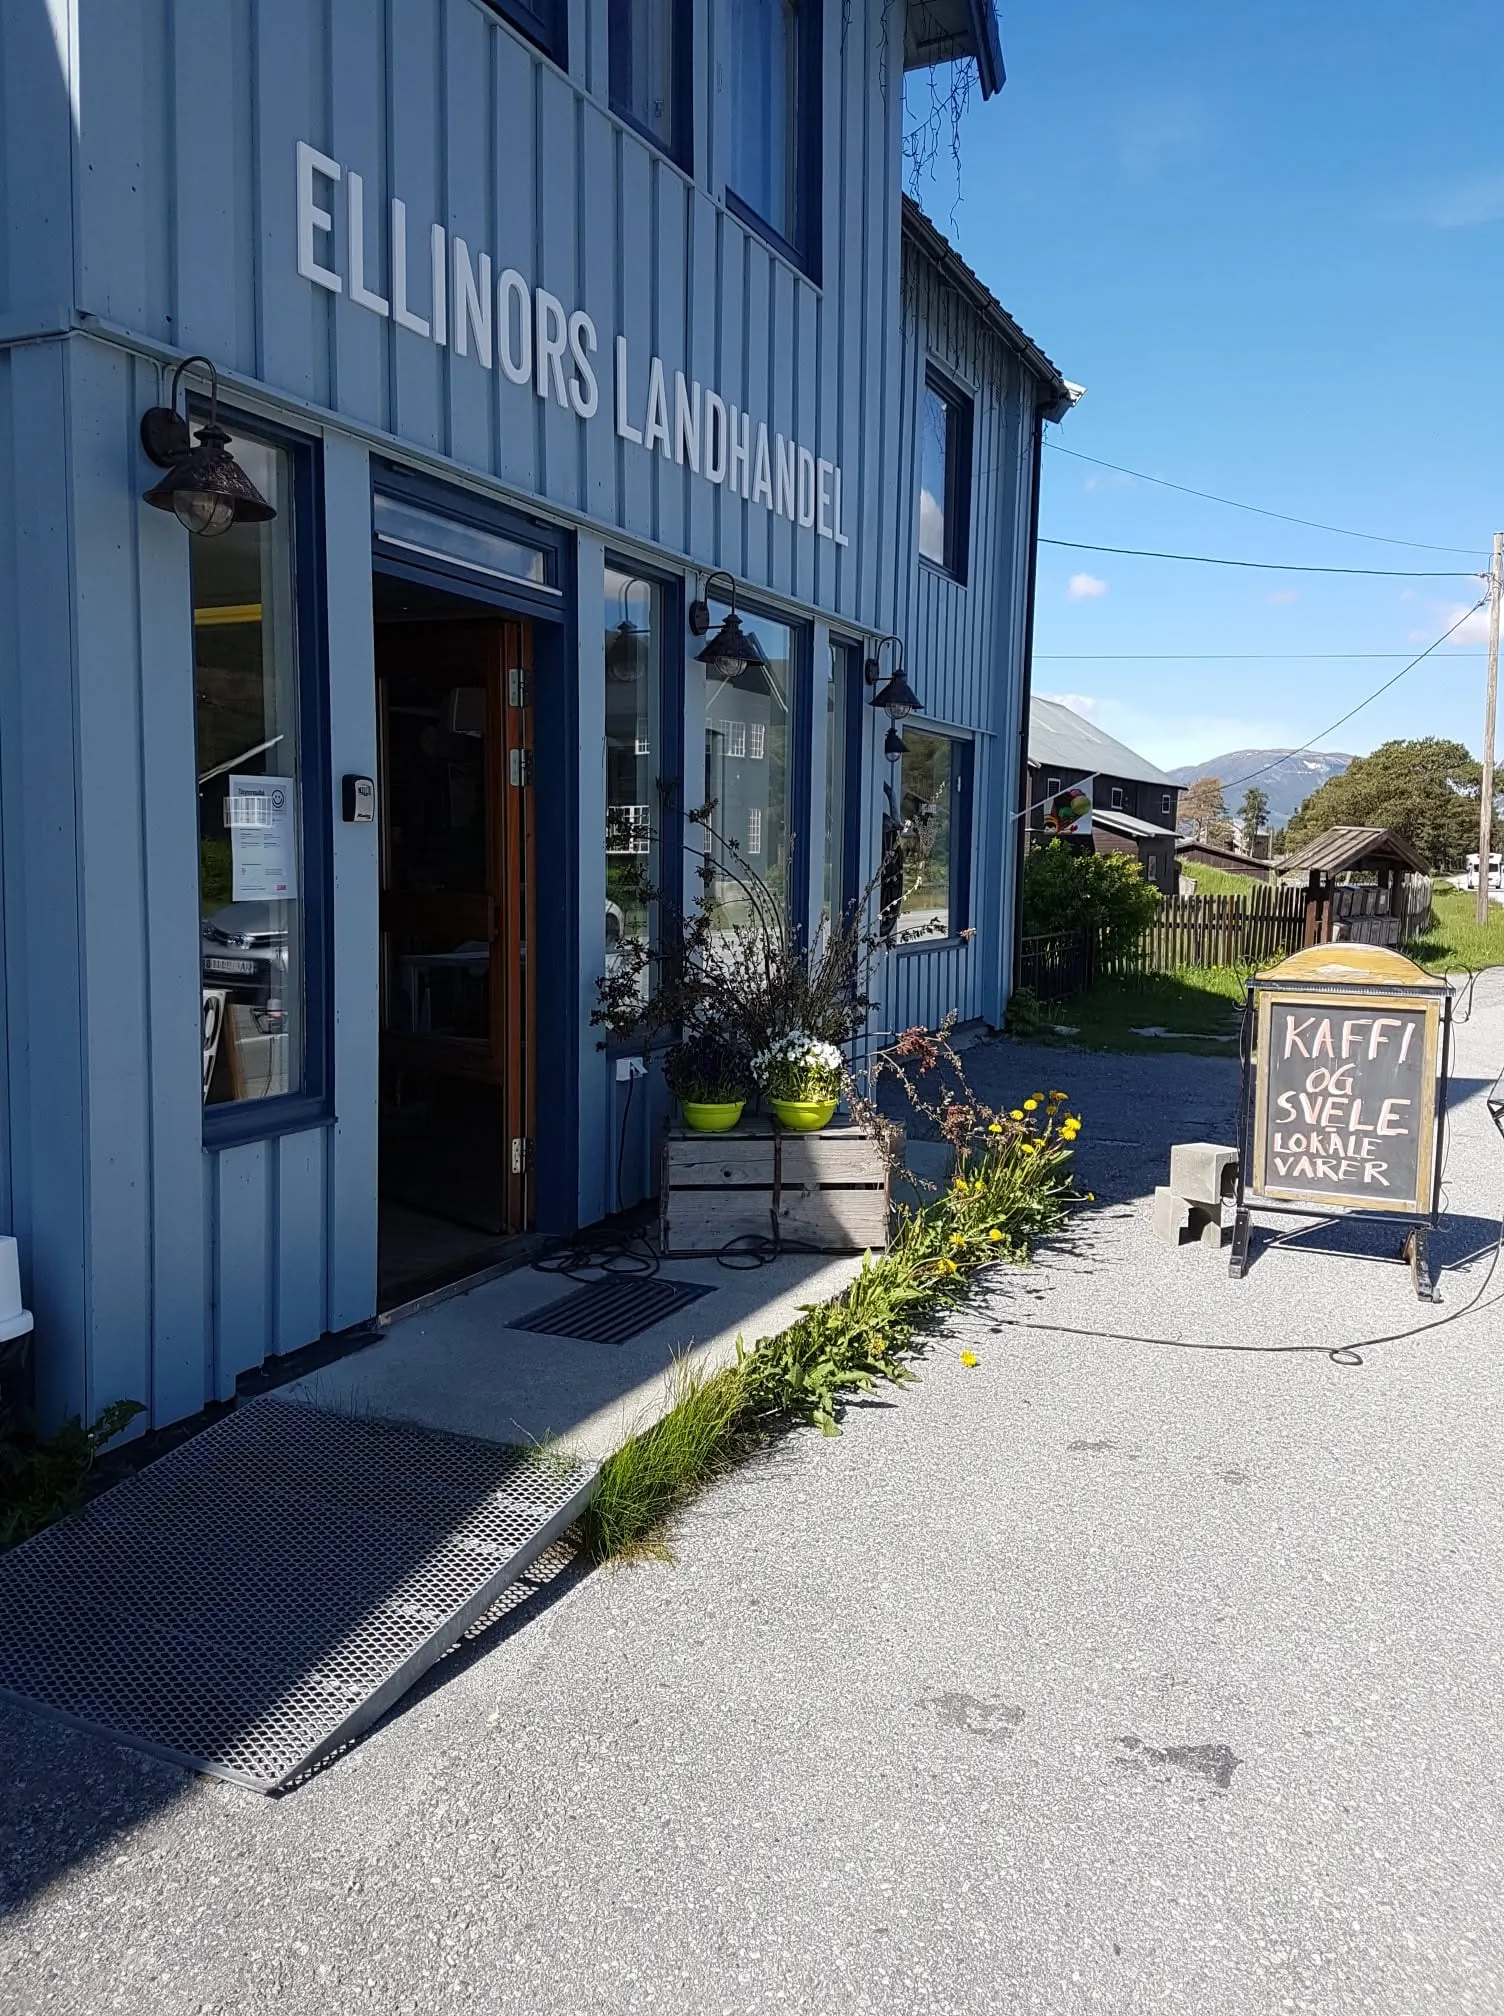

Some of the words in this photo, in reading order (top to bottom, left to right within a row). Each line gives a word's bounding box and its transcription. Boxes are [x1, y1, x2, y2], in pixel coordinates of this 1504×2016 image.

[296, 140, 599, 419] ELLINORS
[616, 335, 849, 547] LANDHANDEL
[1284, 1015, 1416, 1064] KAFFI
[1305, 1063, 1356, 1096] OG
[1275, 1090, 1411, 1136] SVELE
[1273, 1130, 1382, 1159] LOKALE
[1273, 1155, 1391, 1187] VARER
